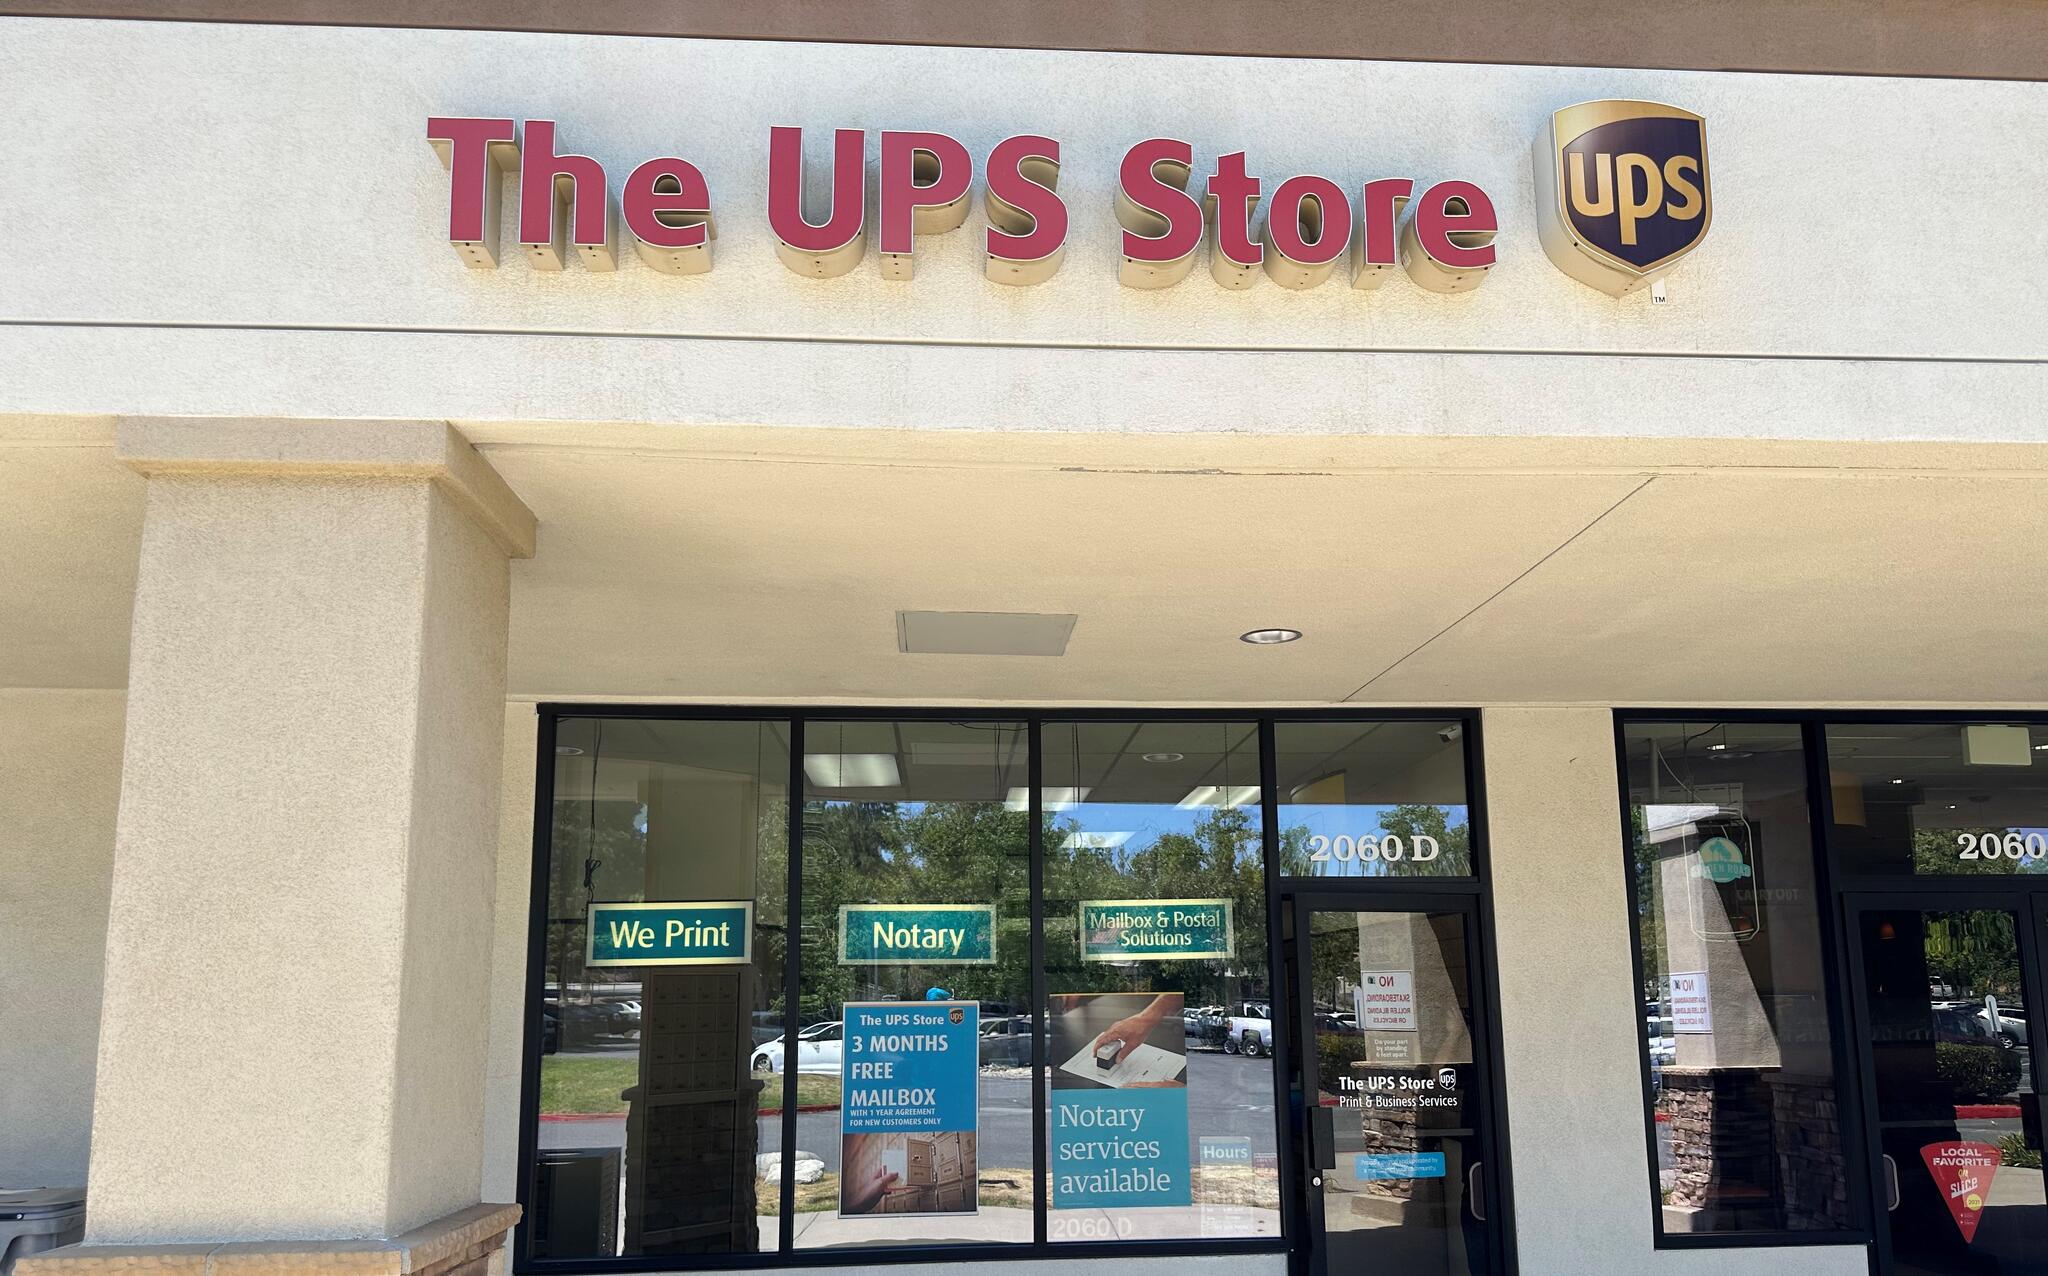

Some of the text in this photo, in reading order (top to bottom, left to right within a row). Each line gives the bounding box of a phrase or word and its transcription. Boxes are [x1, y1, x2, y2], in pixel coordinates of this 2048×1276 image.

[427, 116, 1498, 269] The UPS Store
[1567, 151, 1702, 246] ups
[1309, 834, 1440, 862] 2060 D
[1957, 833, 2047, 860] 2060
[1090, 910, 1221, 929] Mailbox & Postal
[610, 919, 730, 948] We Print
[873, 922, 965, 955] Notary
[1120, 930, 1192, 947] Solutions
[860, 1014, 945, 1026] The UPS Store
[950, 1012, 963, 1023] ups
[852, 1035, 949, 1053] 3 MONTHS
[851, 1062, 893, 1079] FREE
[1338, 1076, 1364, 1090] The
[1368, 1076, 1395, 1090] UPS
[1440, 1074, 1455, 1086] ups
[851, 1088, 936, 1107] MAILBOX
[1340, 1095, 1458, 1107] Print & Business Services
[876, 1108, 893, 1116] YEAR
[895, 1108, 935, 1116] AGREEMENT
[1059, 1104, 1145, 1132] Notary
[850, 1119, 863, 1127] FOR
[882, 1118, 921, 1126] CUSTOMERS
[1059, 1135, 1161, 1161] services
[1203, 1145, 1248, 1159] Hours
[1941, 1148, 1982, 1156] LOCAL
[1933, 1158, 1991, 1166] FAVORITE
[1060, 1167, 1171, 1194] available
[1053, 1217, 1132, 1238] 2060 D
